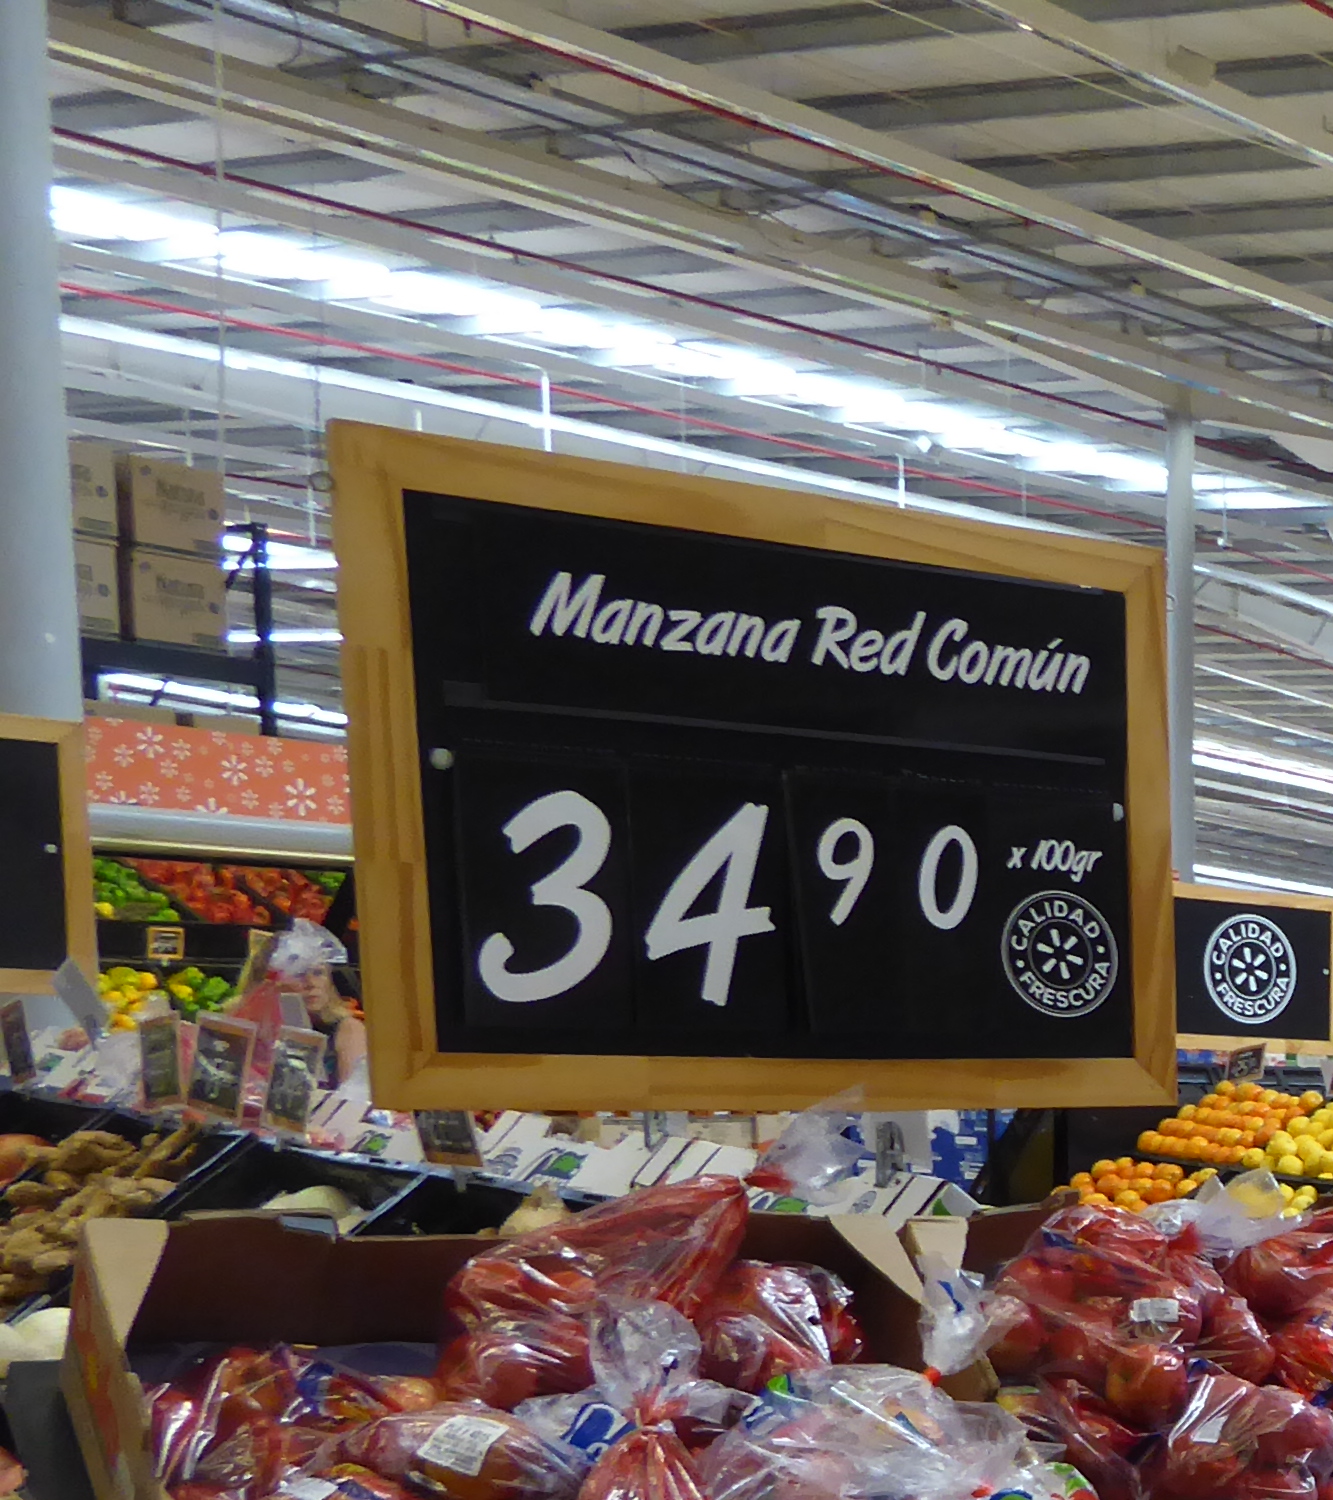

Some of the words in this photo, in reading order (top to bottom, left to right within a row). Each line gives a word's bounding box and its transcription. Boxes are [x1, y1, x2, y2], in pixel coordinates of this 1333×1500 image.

[529, 571, 802, 663] Manzana
[811, 605, 927, 677] Red
[926, 618, 1091, 694] Común
[1006, 846, 1028, 869] x
[1030, 839, 1103, 883] 100gr
[1010, 900, 1101, 951] CALIDAD
[1212, 922, 1285, 965] CALIDAD
[1019, 961, 1111, 1009] FRESCURA
[1216, 977, 1290, 1016] FRESCURA
